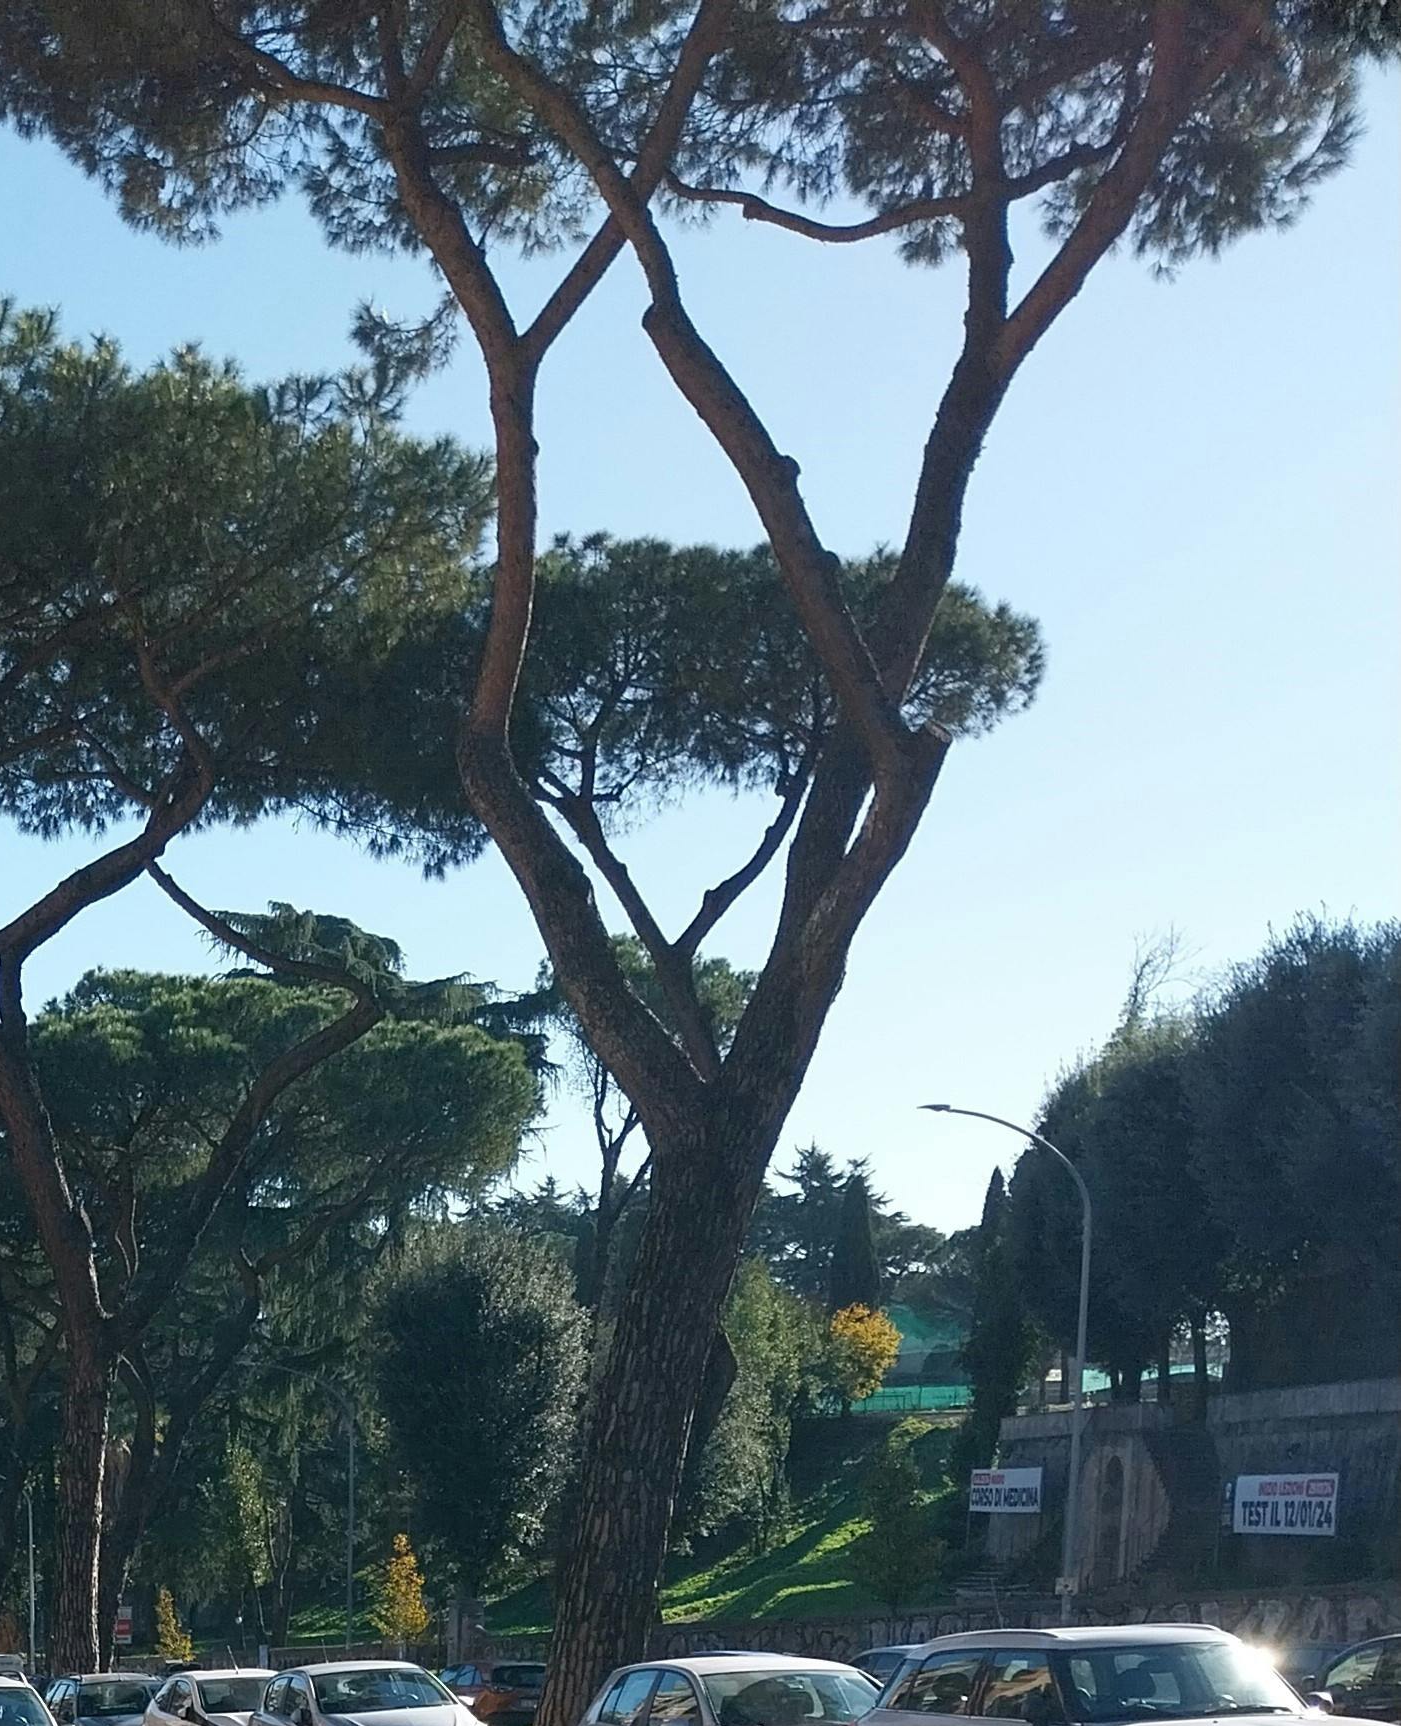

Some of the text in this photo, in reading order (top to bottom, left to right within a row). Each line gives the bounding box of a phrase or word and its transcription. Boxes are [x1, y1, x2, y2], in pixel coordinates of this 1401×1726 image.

[1242, 1501, 1332, 1528] TEST IL 12/01/24
